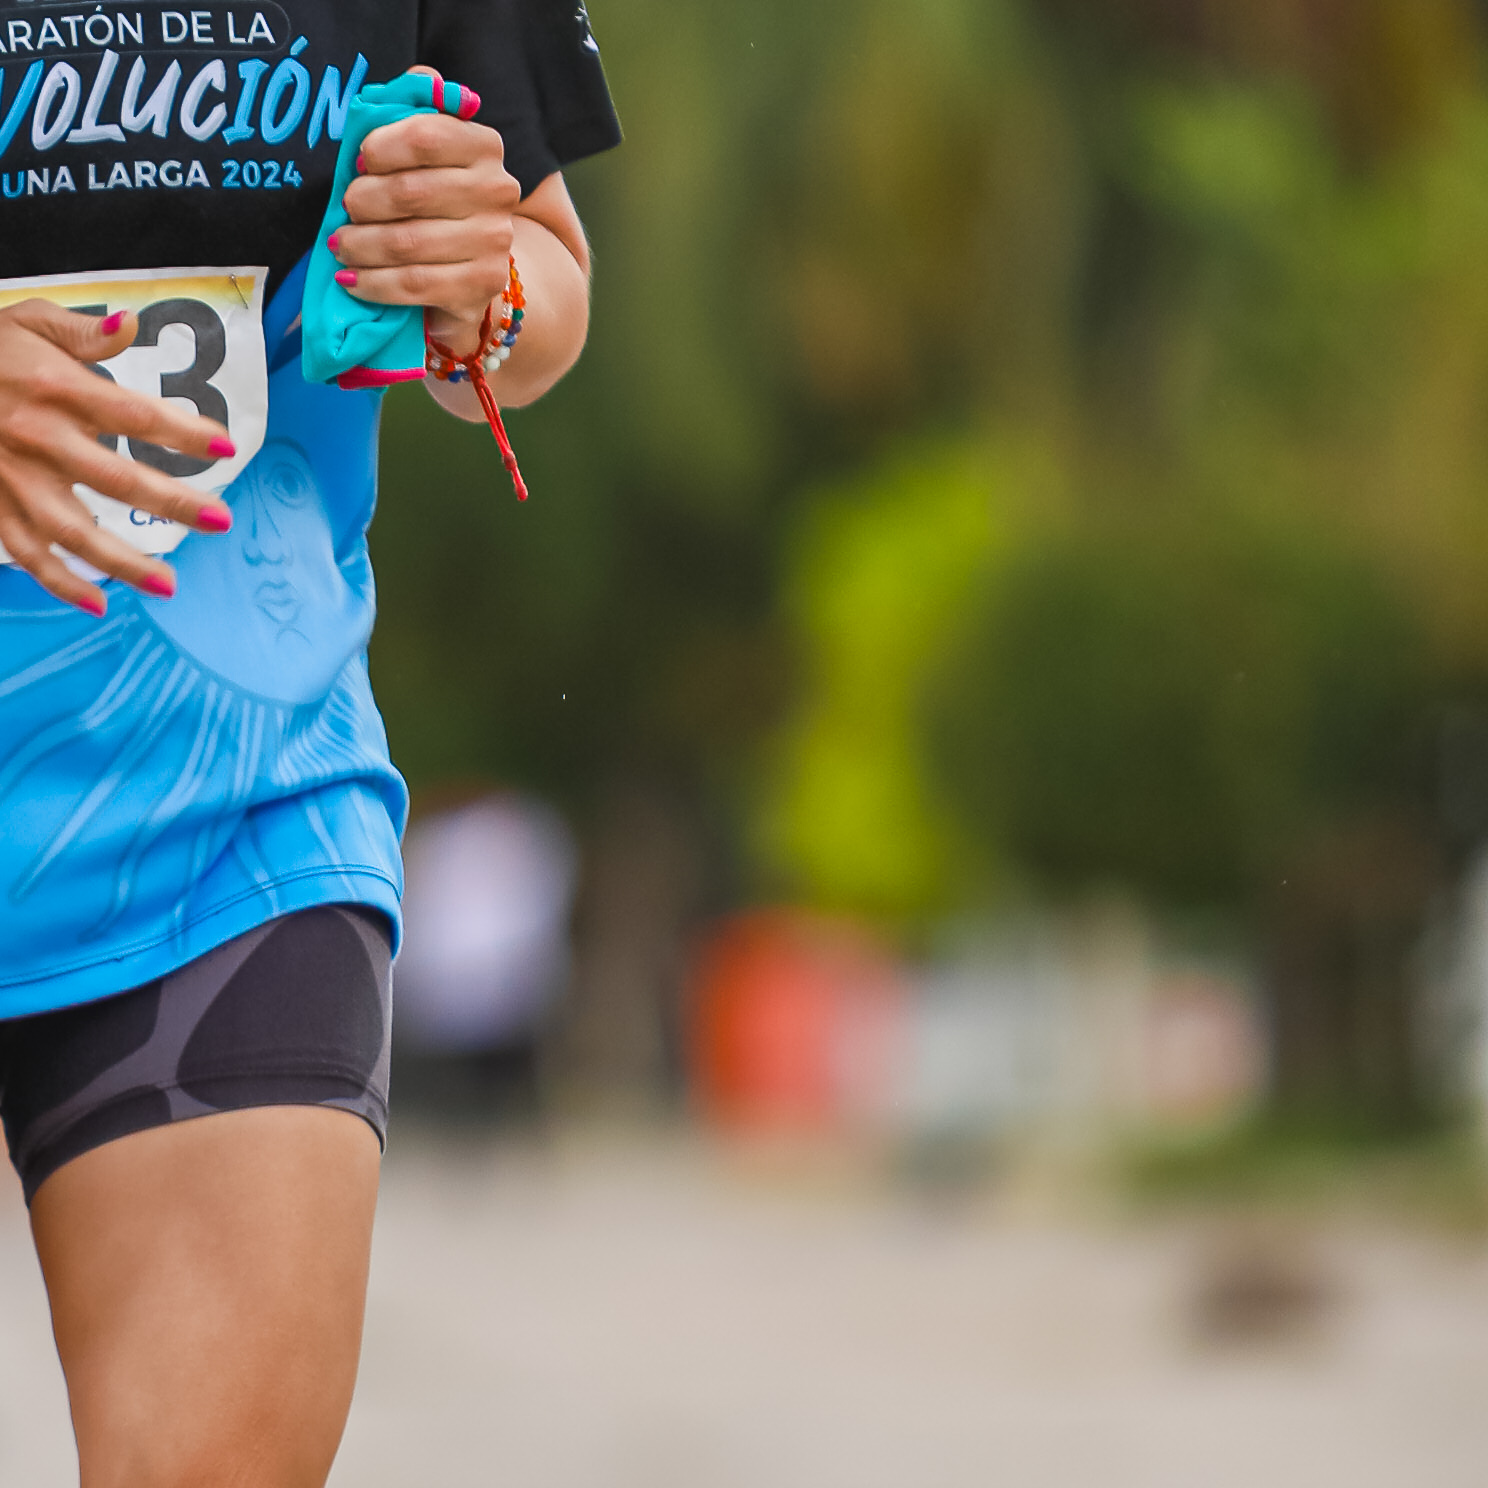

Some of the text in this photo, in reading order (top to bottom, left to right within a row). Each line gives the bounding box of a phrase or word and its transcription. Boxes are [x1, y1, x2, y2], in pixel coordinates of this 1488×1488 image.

[162, 10, 214, 43] DE
[227, 10, 276, 44] LA
[87, 160, 210, 190] LARGA
[222, 159, 303, 189] 2024
